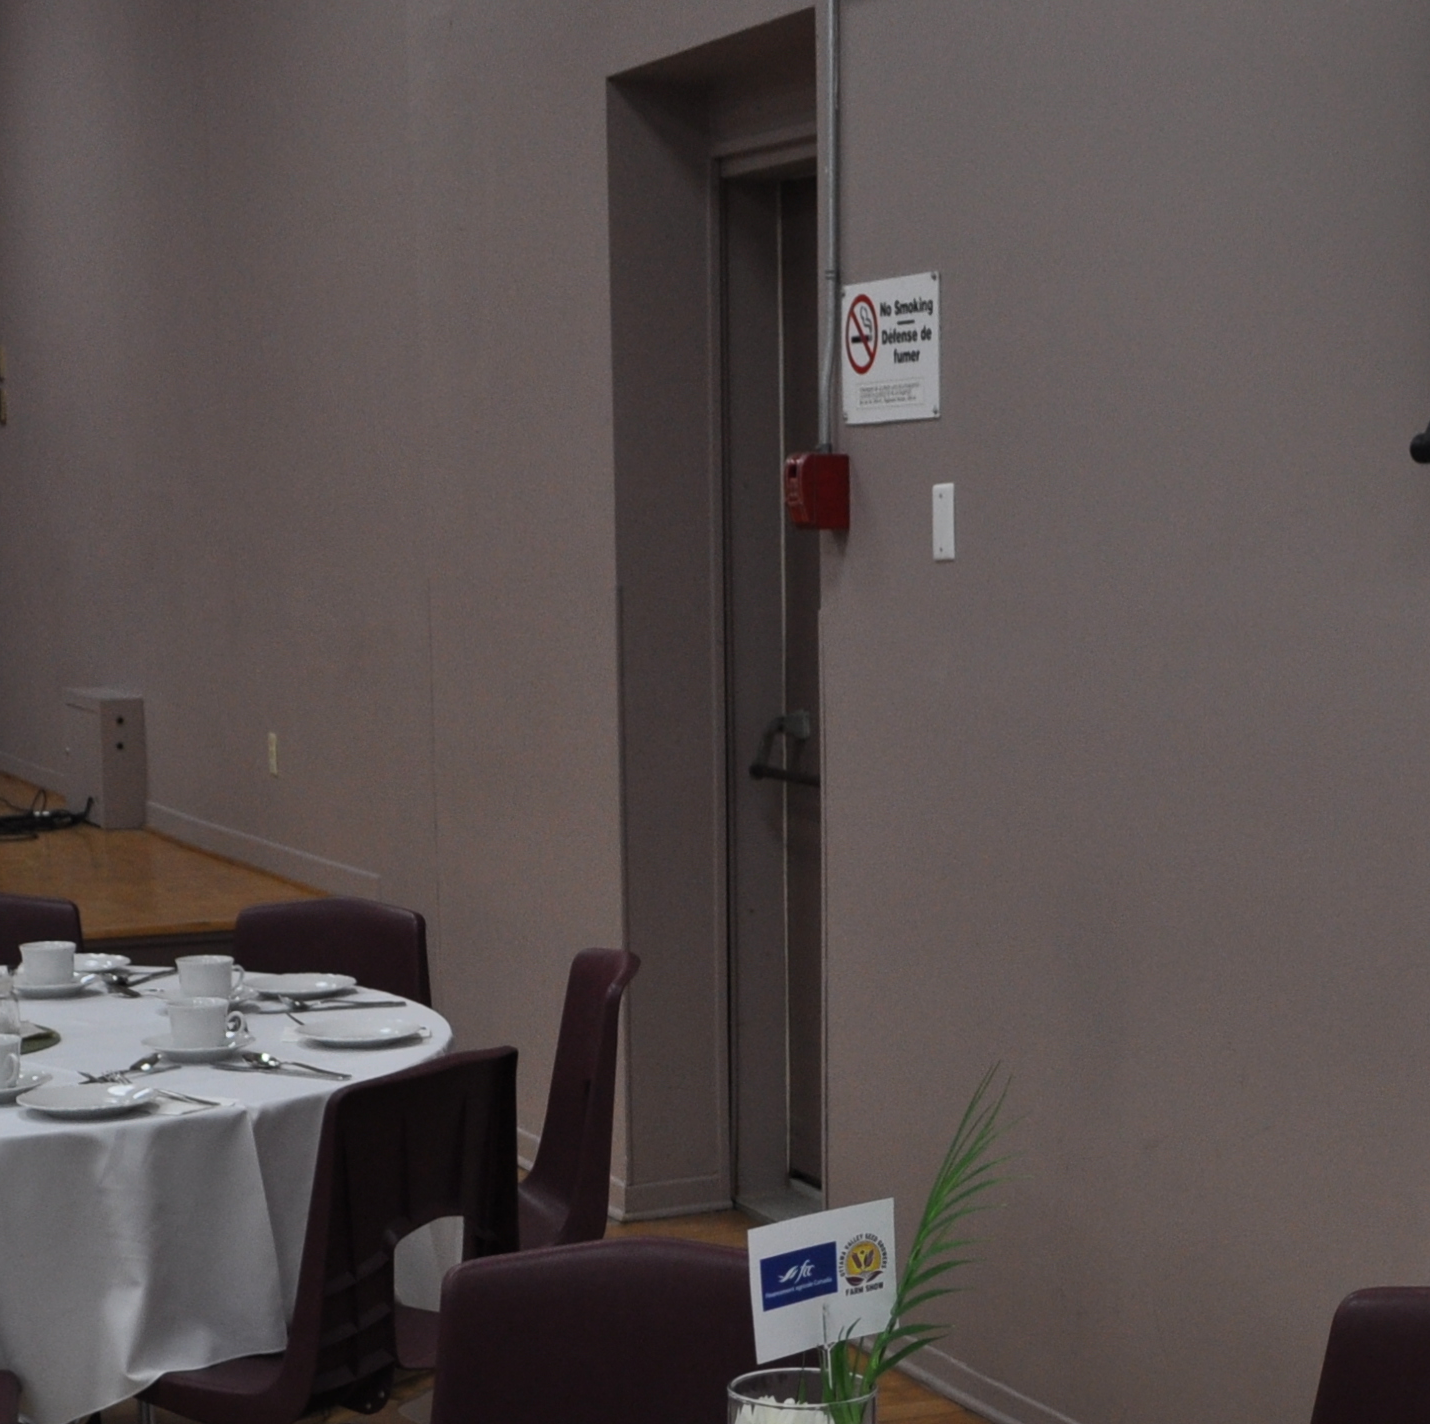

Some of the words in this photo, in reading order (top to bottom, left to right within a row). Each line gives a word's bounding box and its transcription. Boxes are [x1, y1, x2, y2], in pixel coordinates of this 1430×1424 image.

[880, 301, 892, 317] No
[894, 296, 934, 316] Smoking
[881, 328, 918, 345] Défense
[921, 325, 932, 341] de
[893, 348, 920, 364] fumer
[838, 1251, 847, 1277] OTTAWA
[844, 1233, 863, 1250] VALLEY
[865, 1232, 878, 1242] SEED
[877, 1239, 887, 1269] GROWERS
[845, 1286, 864, 1296] FARM
[865, 1282, 884, 1292] SHOW
